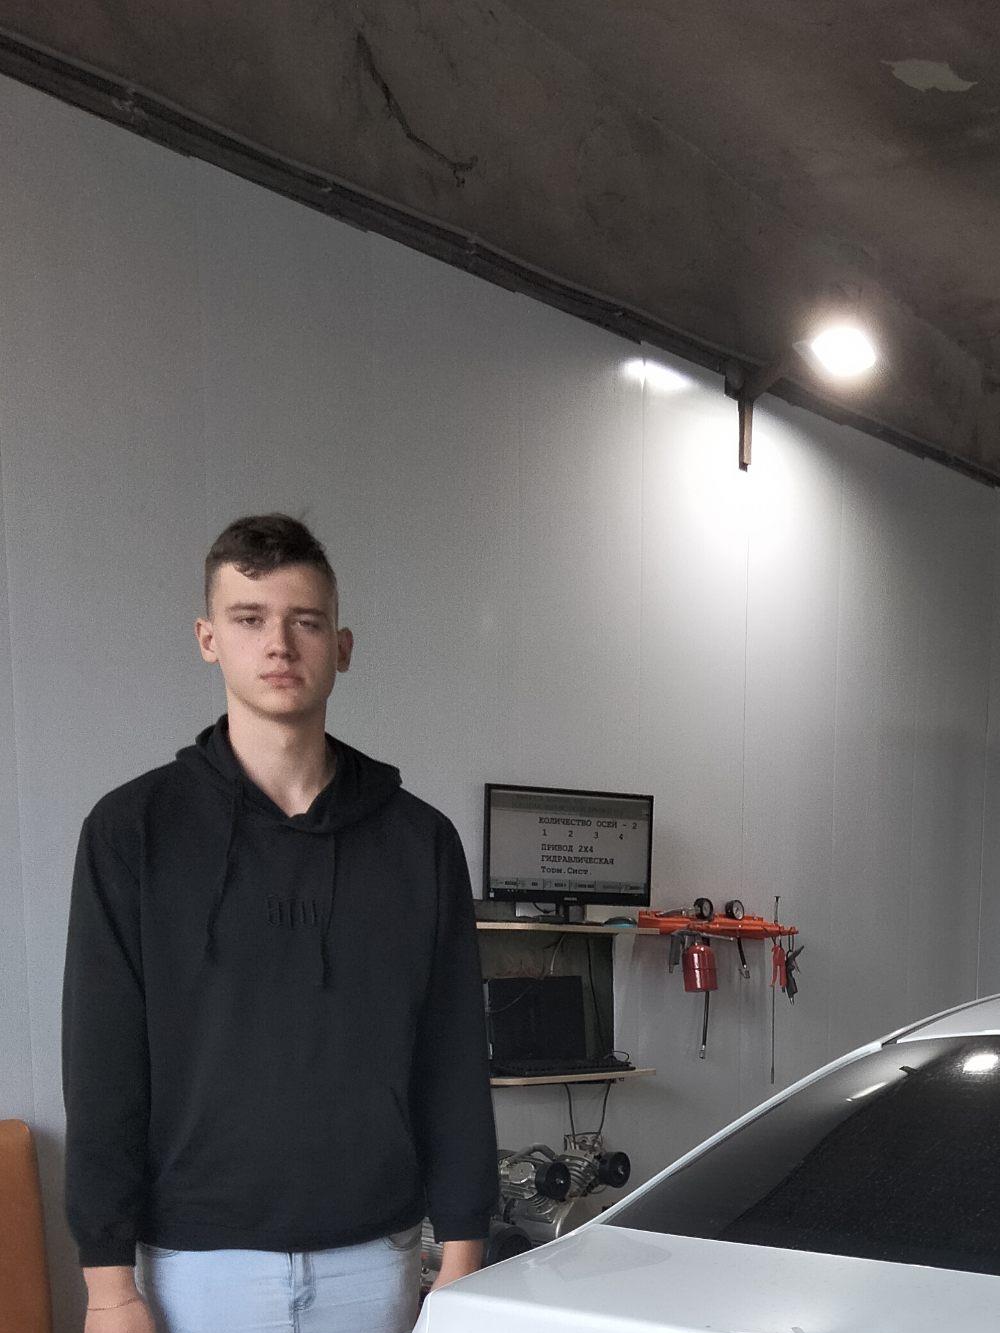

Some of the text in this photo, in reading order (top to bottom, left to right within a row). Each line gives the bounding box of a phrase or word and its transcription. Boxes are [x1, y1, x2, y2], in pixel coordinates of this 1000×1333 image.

[538, 817, 592, 827] КОЛИЧЕСТВО
[632, 822, 637, 830] 2
[542, 829, 548, 837] 1
[593, 832, 599, 840] 3
[540, 844, 573, 853] ПРИВОД
[540, 855, 615, 865] ГИДРАВЛИЧЕСКАЯ
